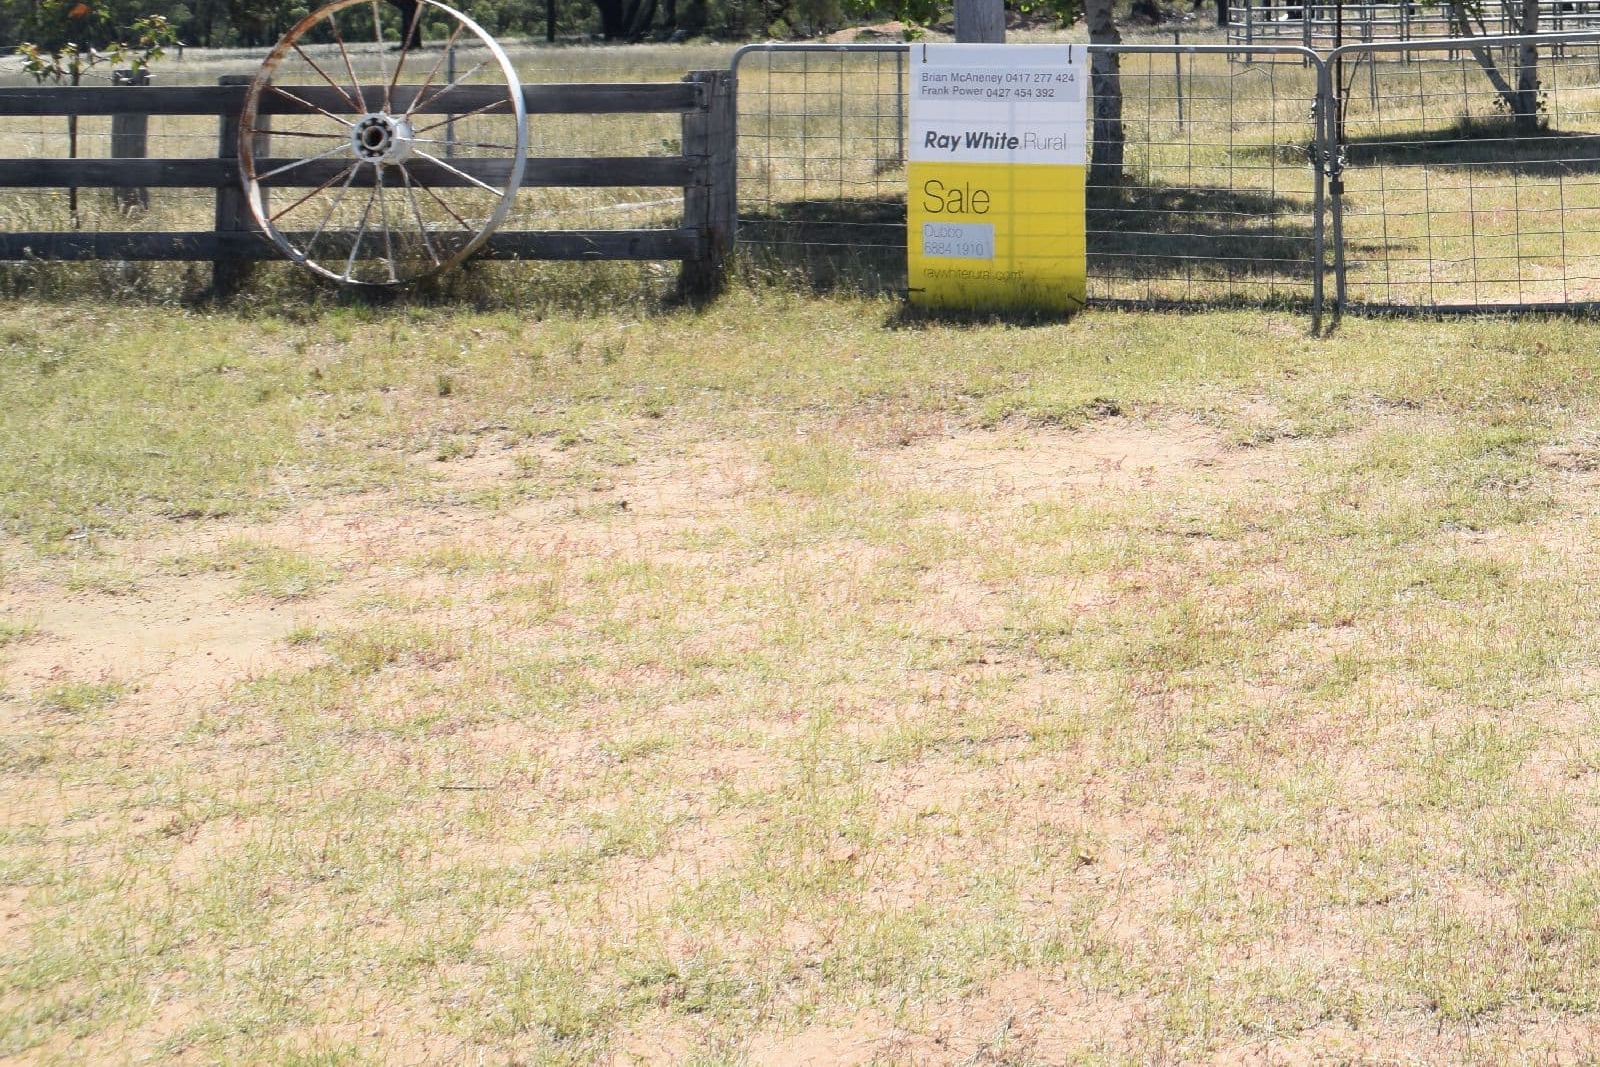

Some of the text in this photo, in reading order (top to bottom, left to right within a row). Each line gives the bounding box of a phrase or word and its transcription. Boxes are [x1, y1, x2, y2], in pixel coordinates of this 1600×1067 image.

[922, 72, 1075, 84] Brian McAneney 0417 277 424
[922, 85, 1055, 98] Frank Power 0427 454 392
[924, 130, 1066, 152] Ray White Rural
[923, 179, 990, 214] Sale
[924, 223, 963, 238] Dubbo
